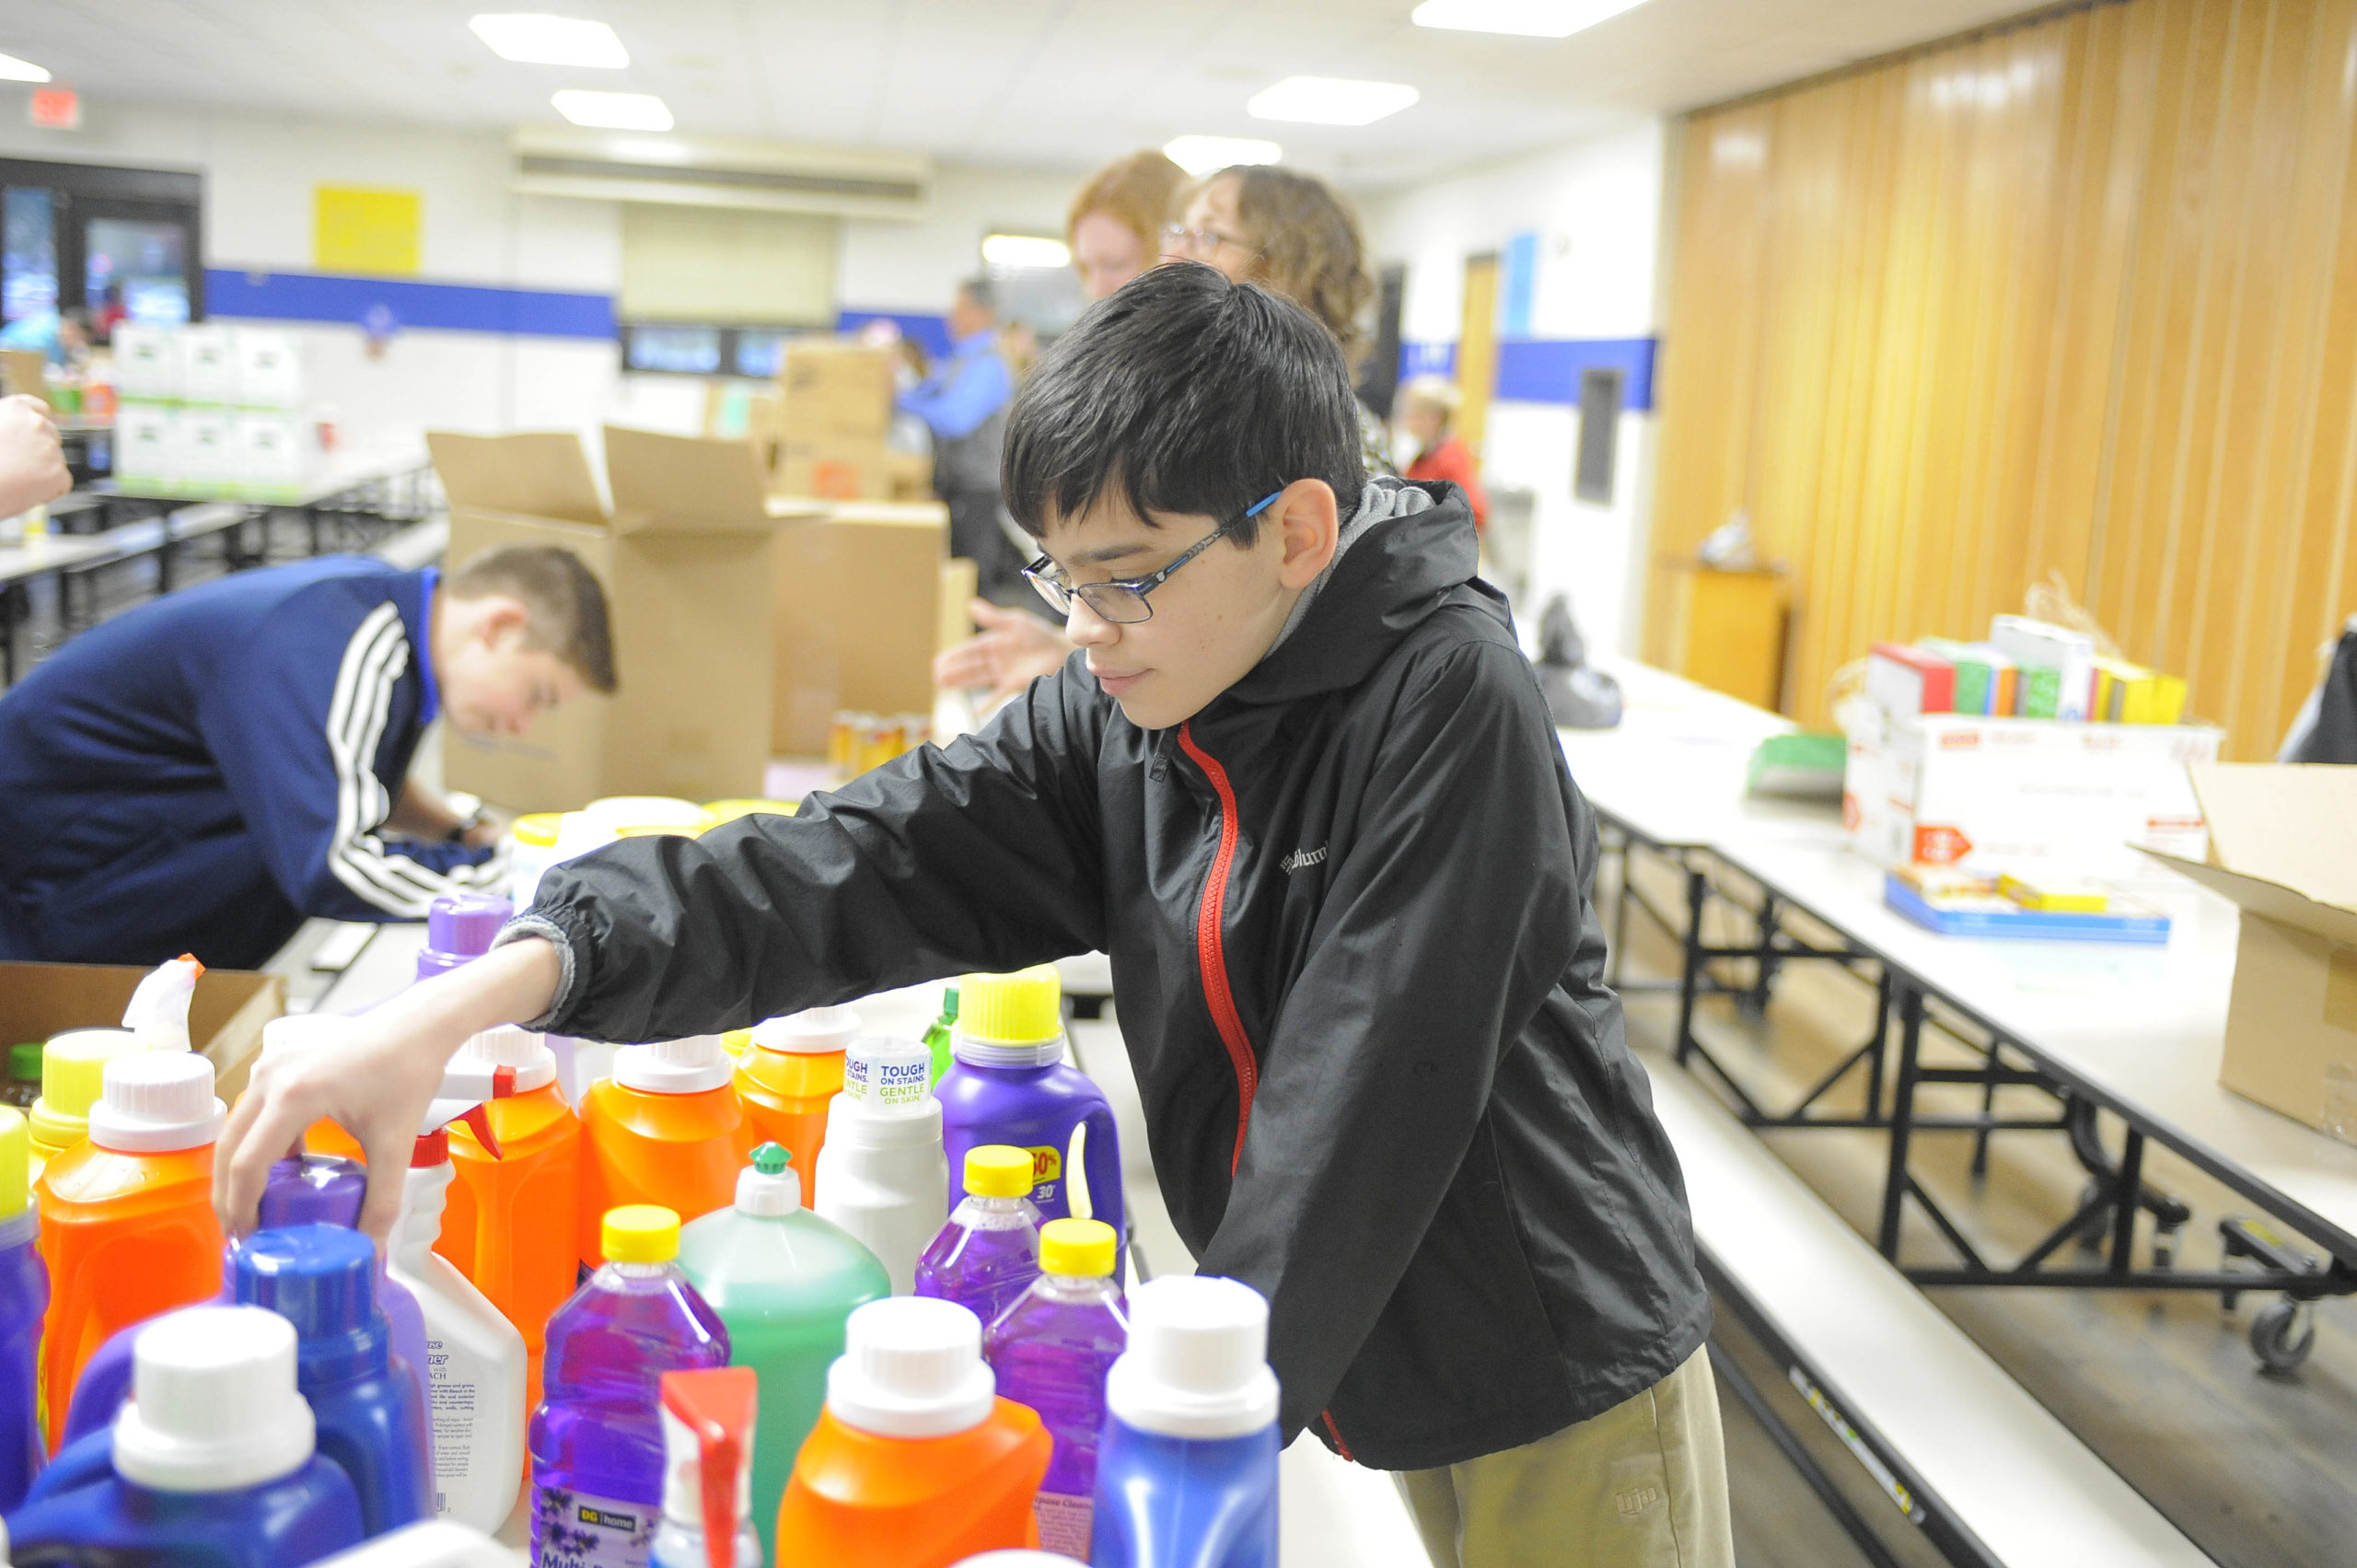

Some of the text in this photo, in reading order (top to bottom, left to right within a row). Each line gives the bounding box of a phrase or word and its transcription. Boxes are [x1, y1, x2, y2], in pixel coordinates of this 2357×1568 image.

[881, 1063, 925, 1077] TOUGH
[880, 1077, 895, 1086] ON
[879, 1083, 925, 1098] GENTLE
[582, 1509, 633, 1528] DG home
